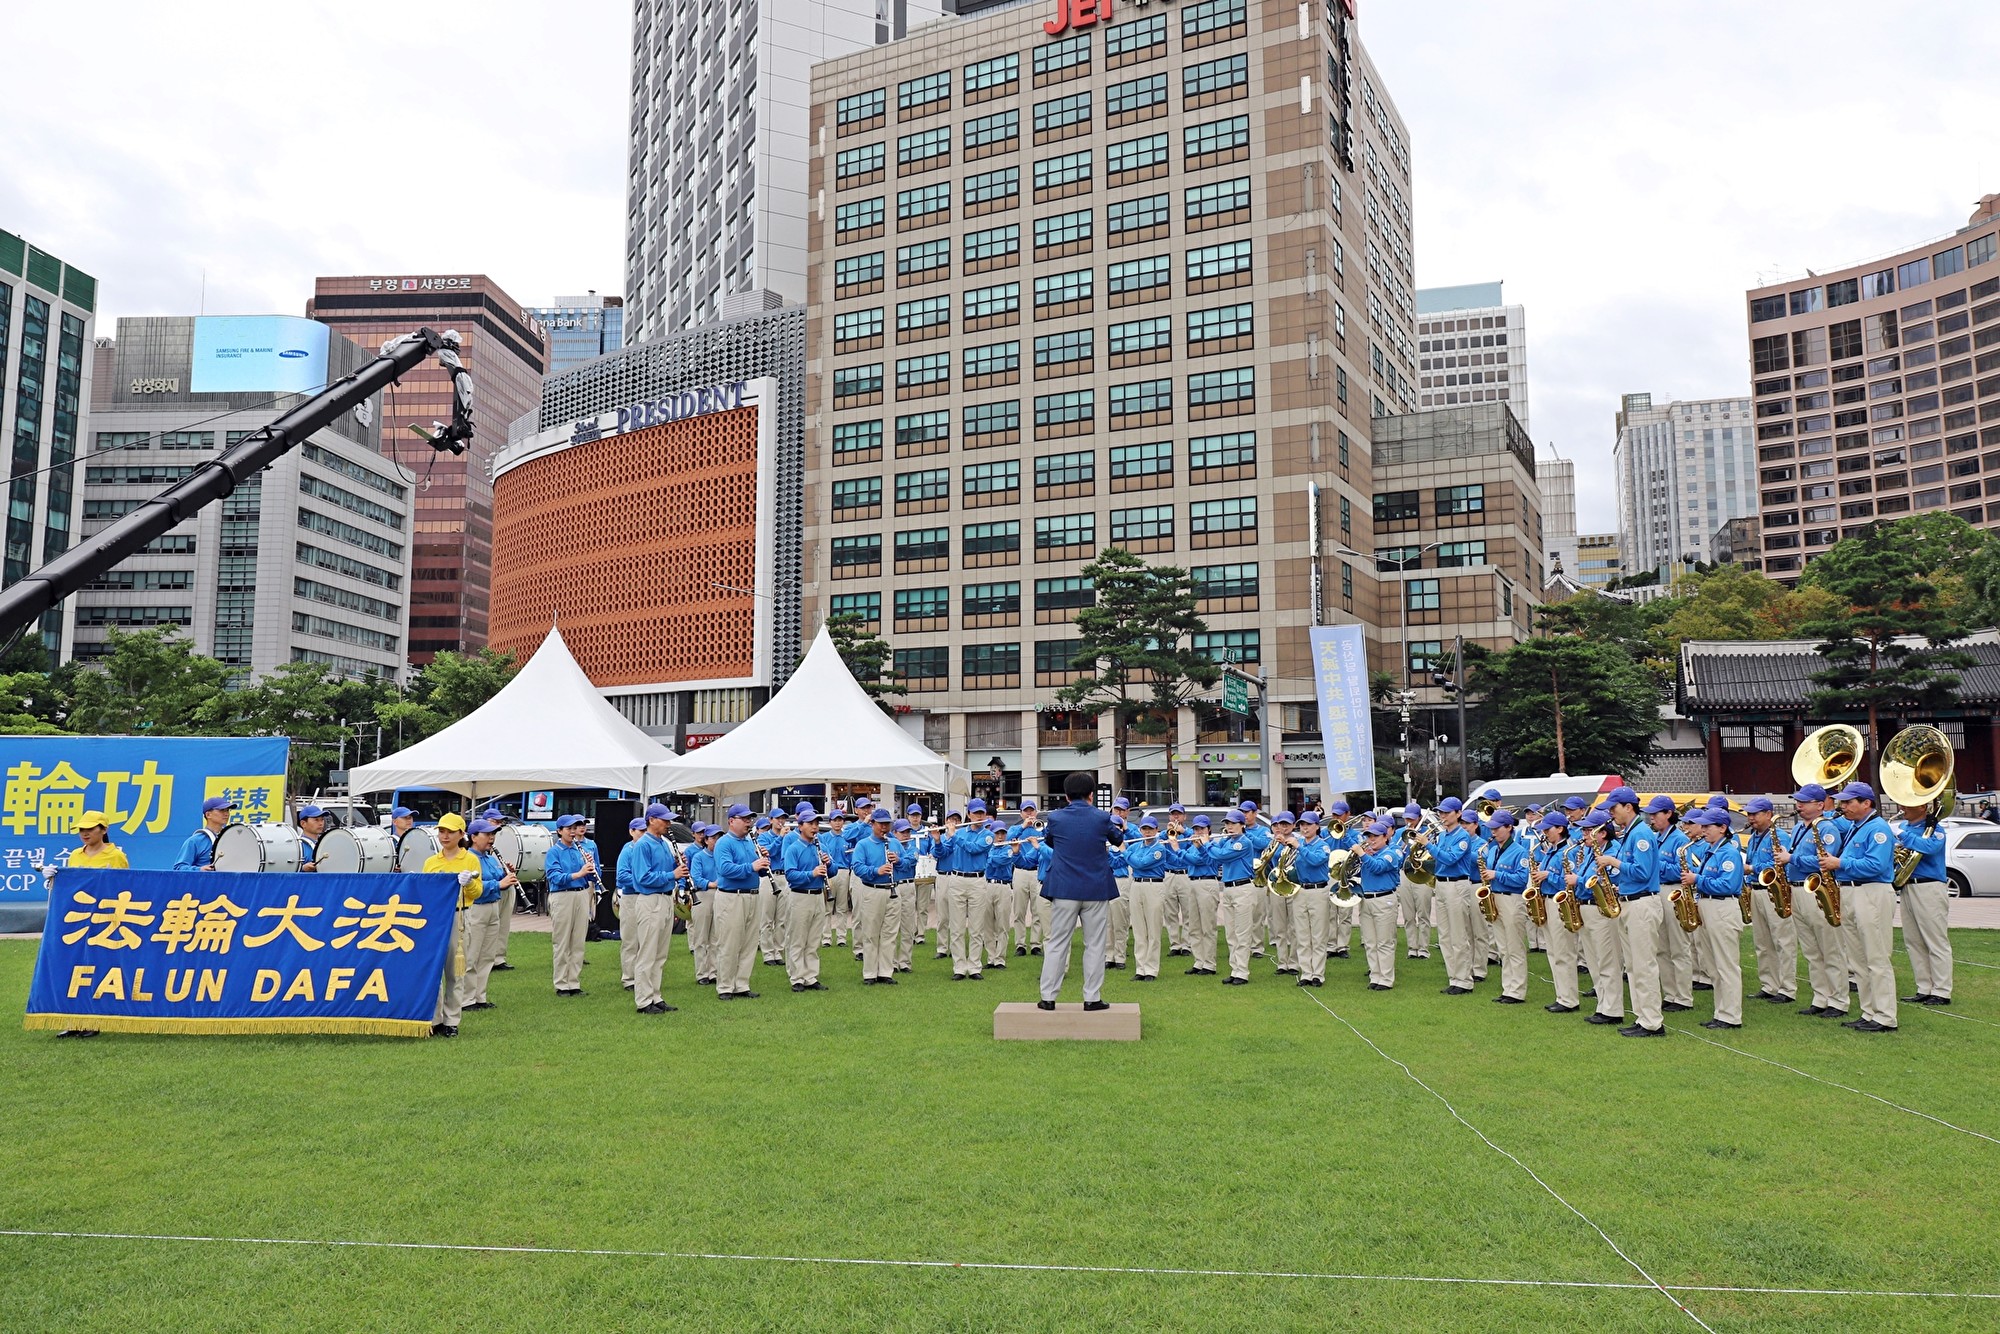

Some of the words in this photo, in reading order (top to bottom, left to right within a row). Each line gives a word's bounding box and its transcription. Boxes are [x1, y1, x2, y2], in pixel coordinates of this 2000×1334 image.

[369, 279, 398, 291] 부영
[420, 278, 472, 291] 사랑으로
[538, 319, 556, 328] ana
[557, 317, 583, 328] Bank
[130, 377, 180, 394] 삼성화재
[616, 381, 748, 434] PRESIDENT
[1203, 753, 1225, 763] CU
[2, 760, 175, 836] 輪功
[222, 786, 271, 810] 結束
[62, 890, 428, 955] 法輪大法
[67, 965, 228, 1002] FALUN
[250, 967, 389, 1002] DAFA
